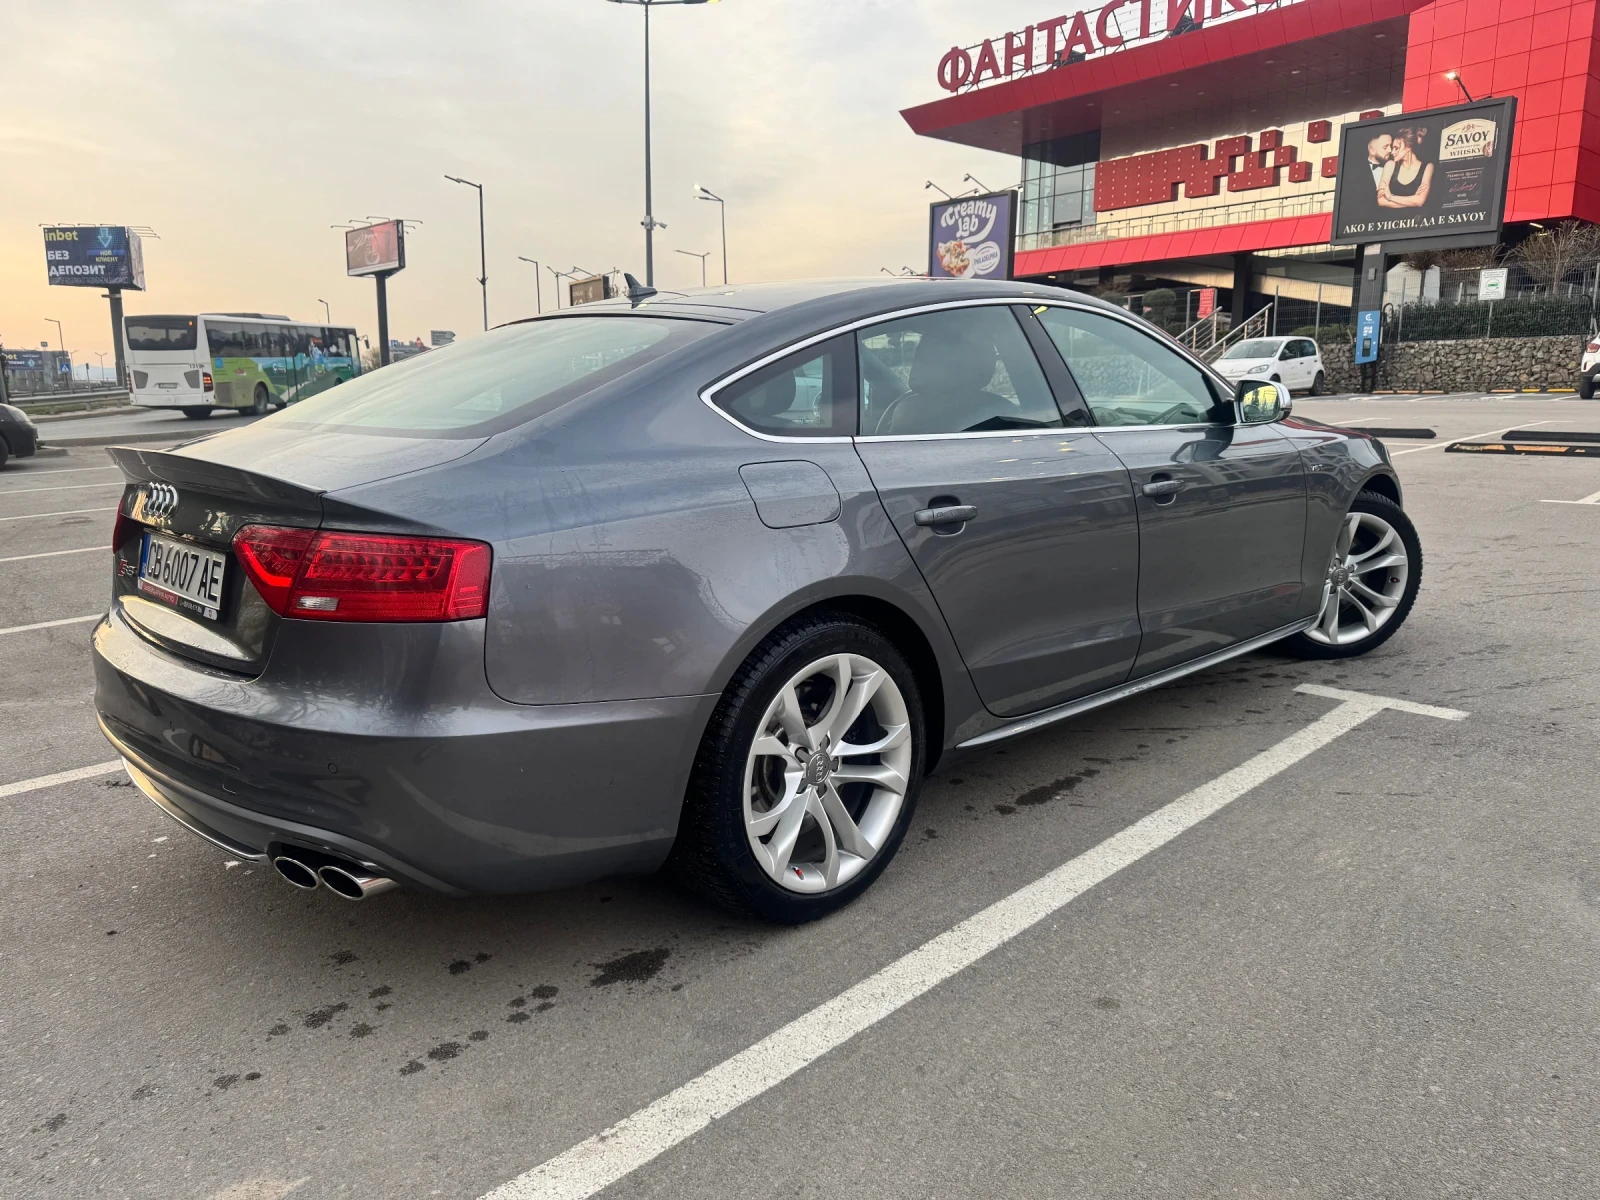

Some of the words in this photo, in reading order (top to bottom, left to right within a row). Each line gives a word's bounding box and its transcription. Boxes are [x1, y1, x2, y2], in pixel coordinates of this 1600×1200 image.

[1444, 130, 1490, 149] SAVOY
[1450, 147, 1483, 157] WHISKY
[941, 200, 997, 243] Creamy
[956, 214, 979, 238] Lab
[1343, 223, 1365, 234] АКО
[1367, 222, 1375, 232] Е
[1376, 218, 1418, 231] УИСКИ,
[1419, 216, 1436, 228] ДА
[1438, 215, 1446, 225] Е
[1447, 211, 1487, 224] SAVOY
[44, 229, 79, 241] inbet
[47, 250, 70, 261] БЕЗ
[974, 251, 998, 266] PHILADELPHIA
[49, 265, 106, 276] ДЕПОЗИТ
[147, 540, 164, 579] CB
[163, 545, 200, 592] 6007
[197, 556, 222, 602] AE
